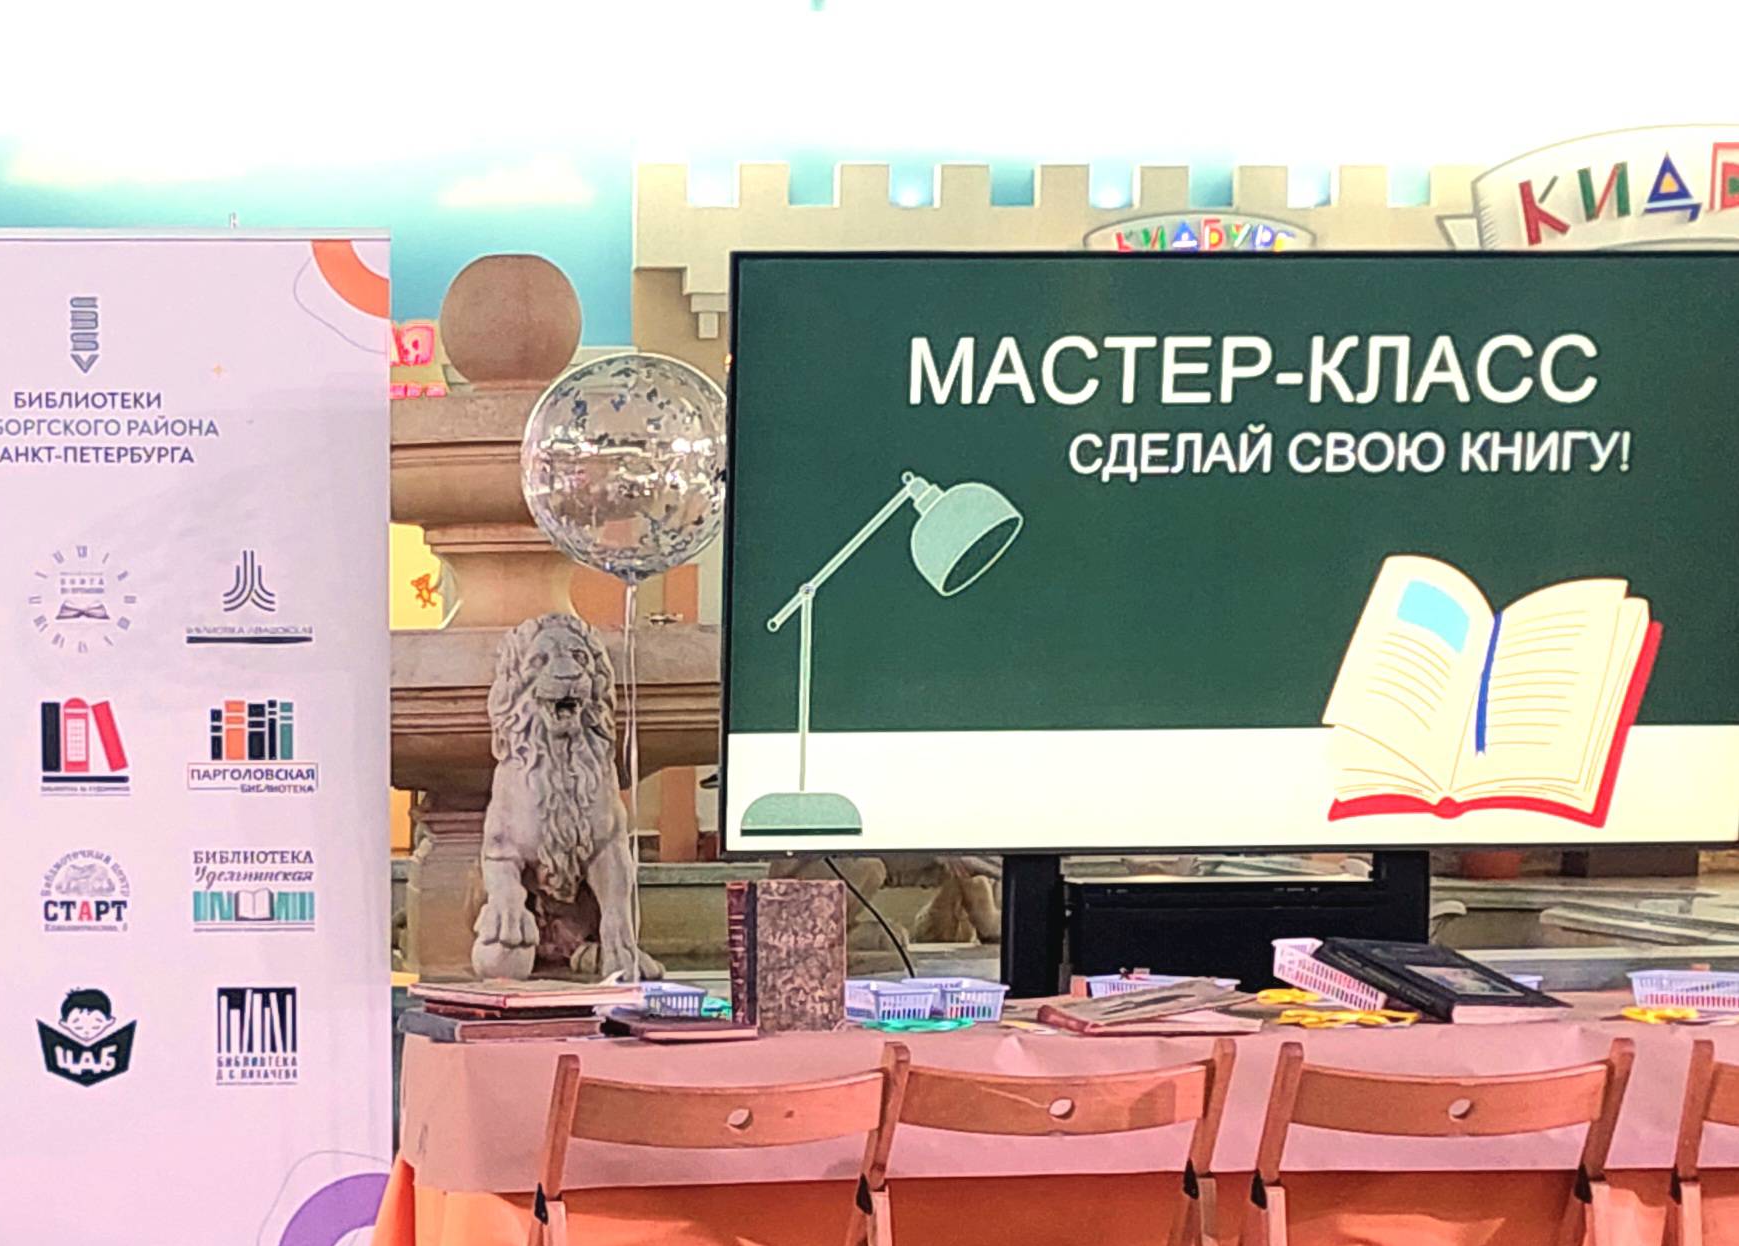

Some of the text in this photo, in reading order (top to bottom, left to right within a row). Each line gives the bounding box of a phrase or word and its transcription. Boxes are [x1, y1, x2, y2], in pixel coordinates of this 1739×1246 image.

[909, 334, 1599, 405] МАСТЕР-КЛАСС
[13, 391, 162, 410] БИБЛИОТЕКИ
[127, 414, 219, 437] РАЙОНА
[1068, 423, 1632, 483] СДЕЛАЙ СВОЮ КНИГУ!
[191, 768, 315, 780] ПАРГОЛОВСКАЯ
[193, 850, 314, 864] БИБЛИОТЕКА
[43, 900, 127, 921] СТАРТ
